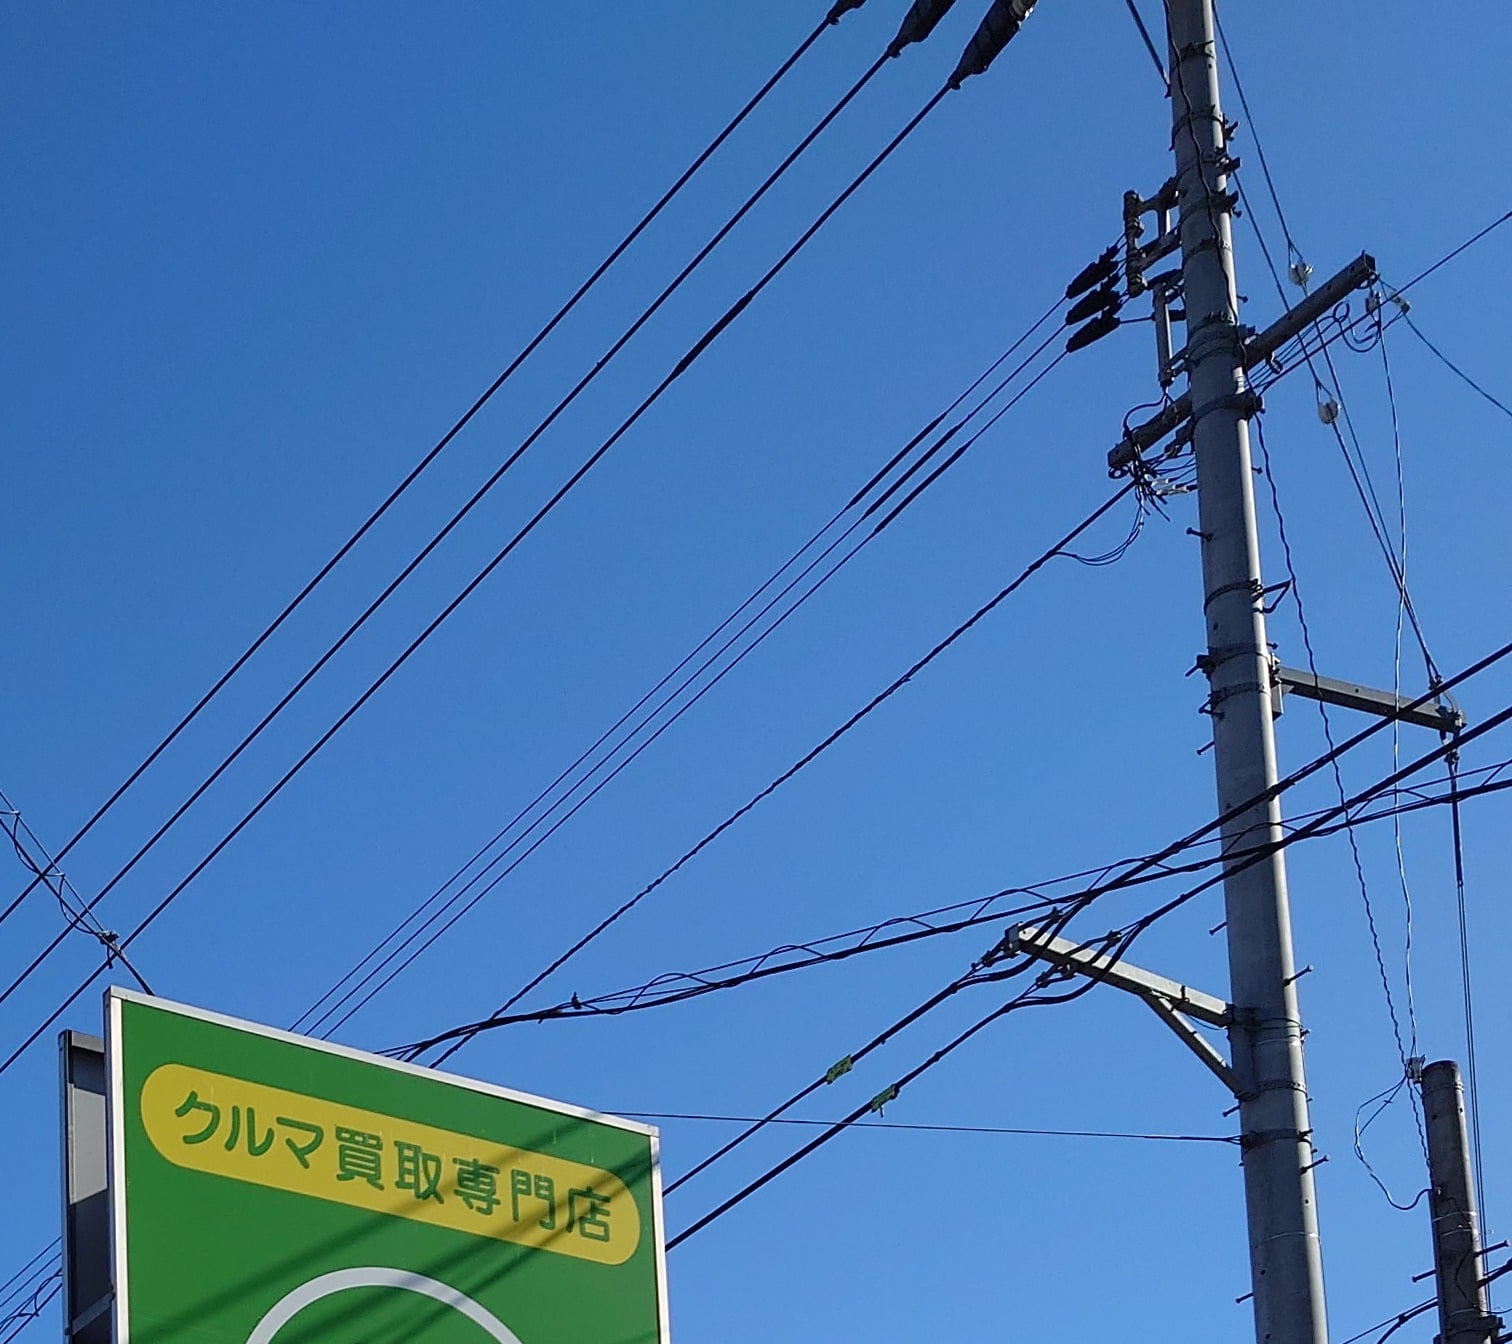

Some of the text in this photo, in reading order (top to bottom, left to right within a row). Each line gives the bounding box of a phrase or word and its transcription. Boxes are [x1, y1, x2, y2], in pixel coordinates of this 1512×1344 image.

[174, 1090, 611, 1243] クルマ買取専門店
